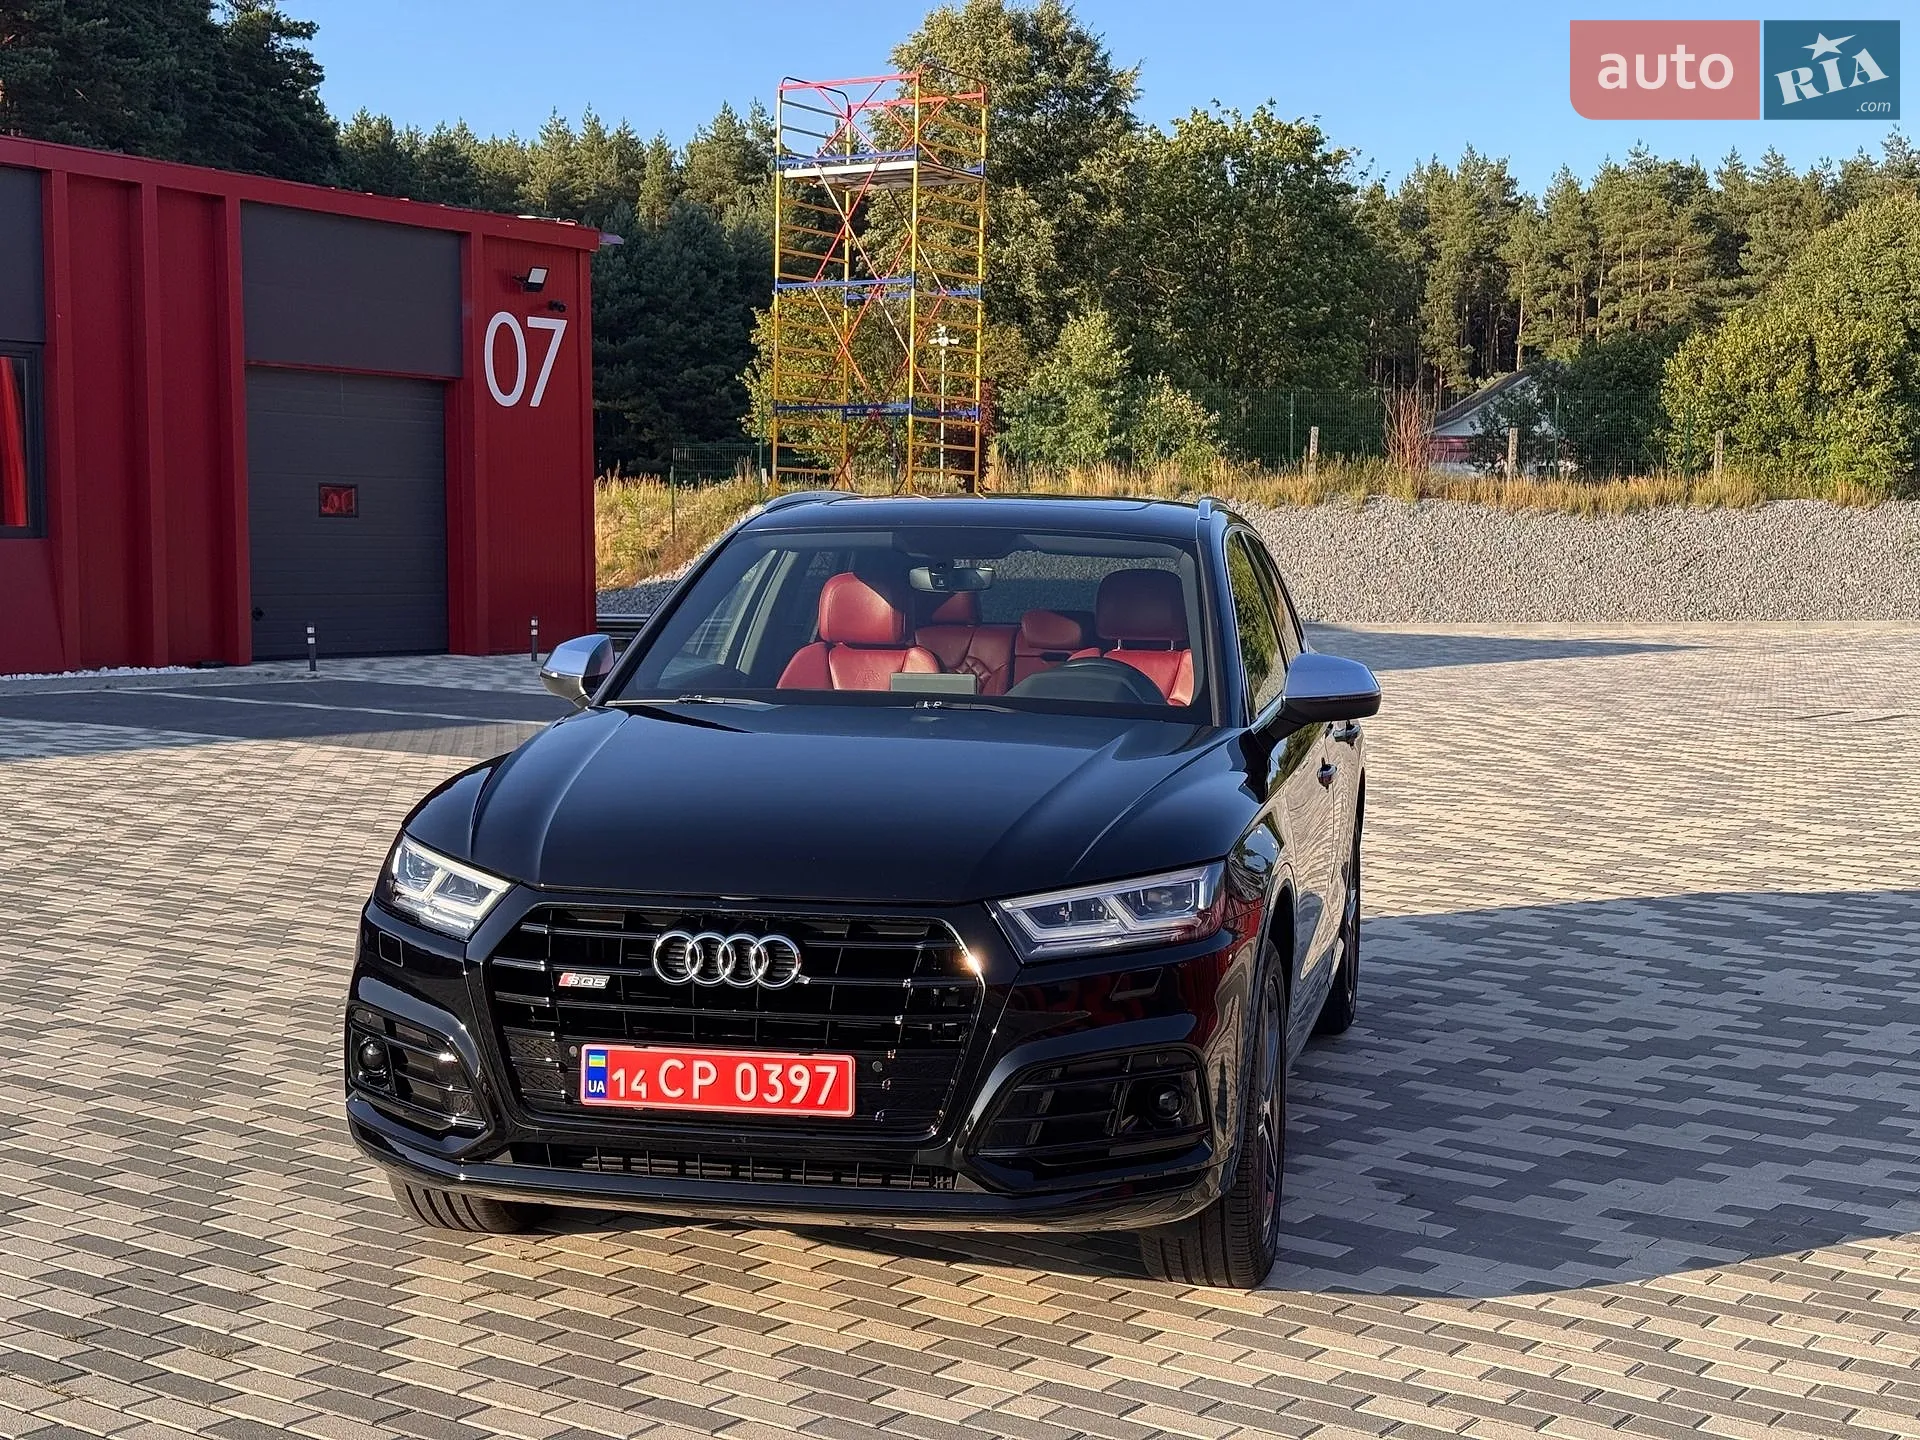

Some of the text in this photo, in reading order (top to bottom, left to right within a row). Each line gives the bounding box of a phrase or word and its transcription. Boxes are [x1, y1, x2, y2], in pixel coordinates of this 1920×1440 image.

[484, 311, 568, 407] 07
[564, 973, 609, 988] SQ5
[588, 1080, 605, 1093] UA
[612, 1058, 838, 1106] 14 CP 0397
